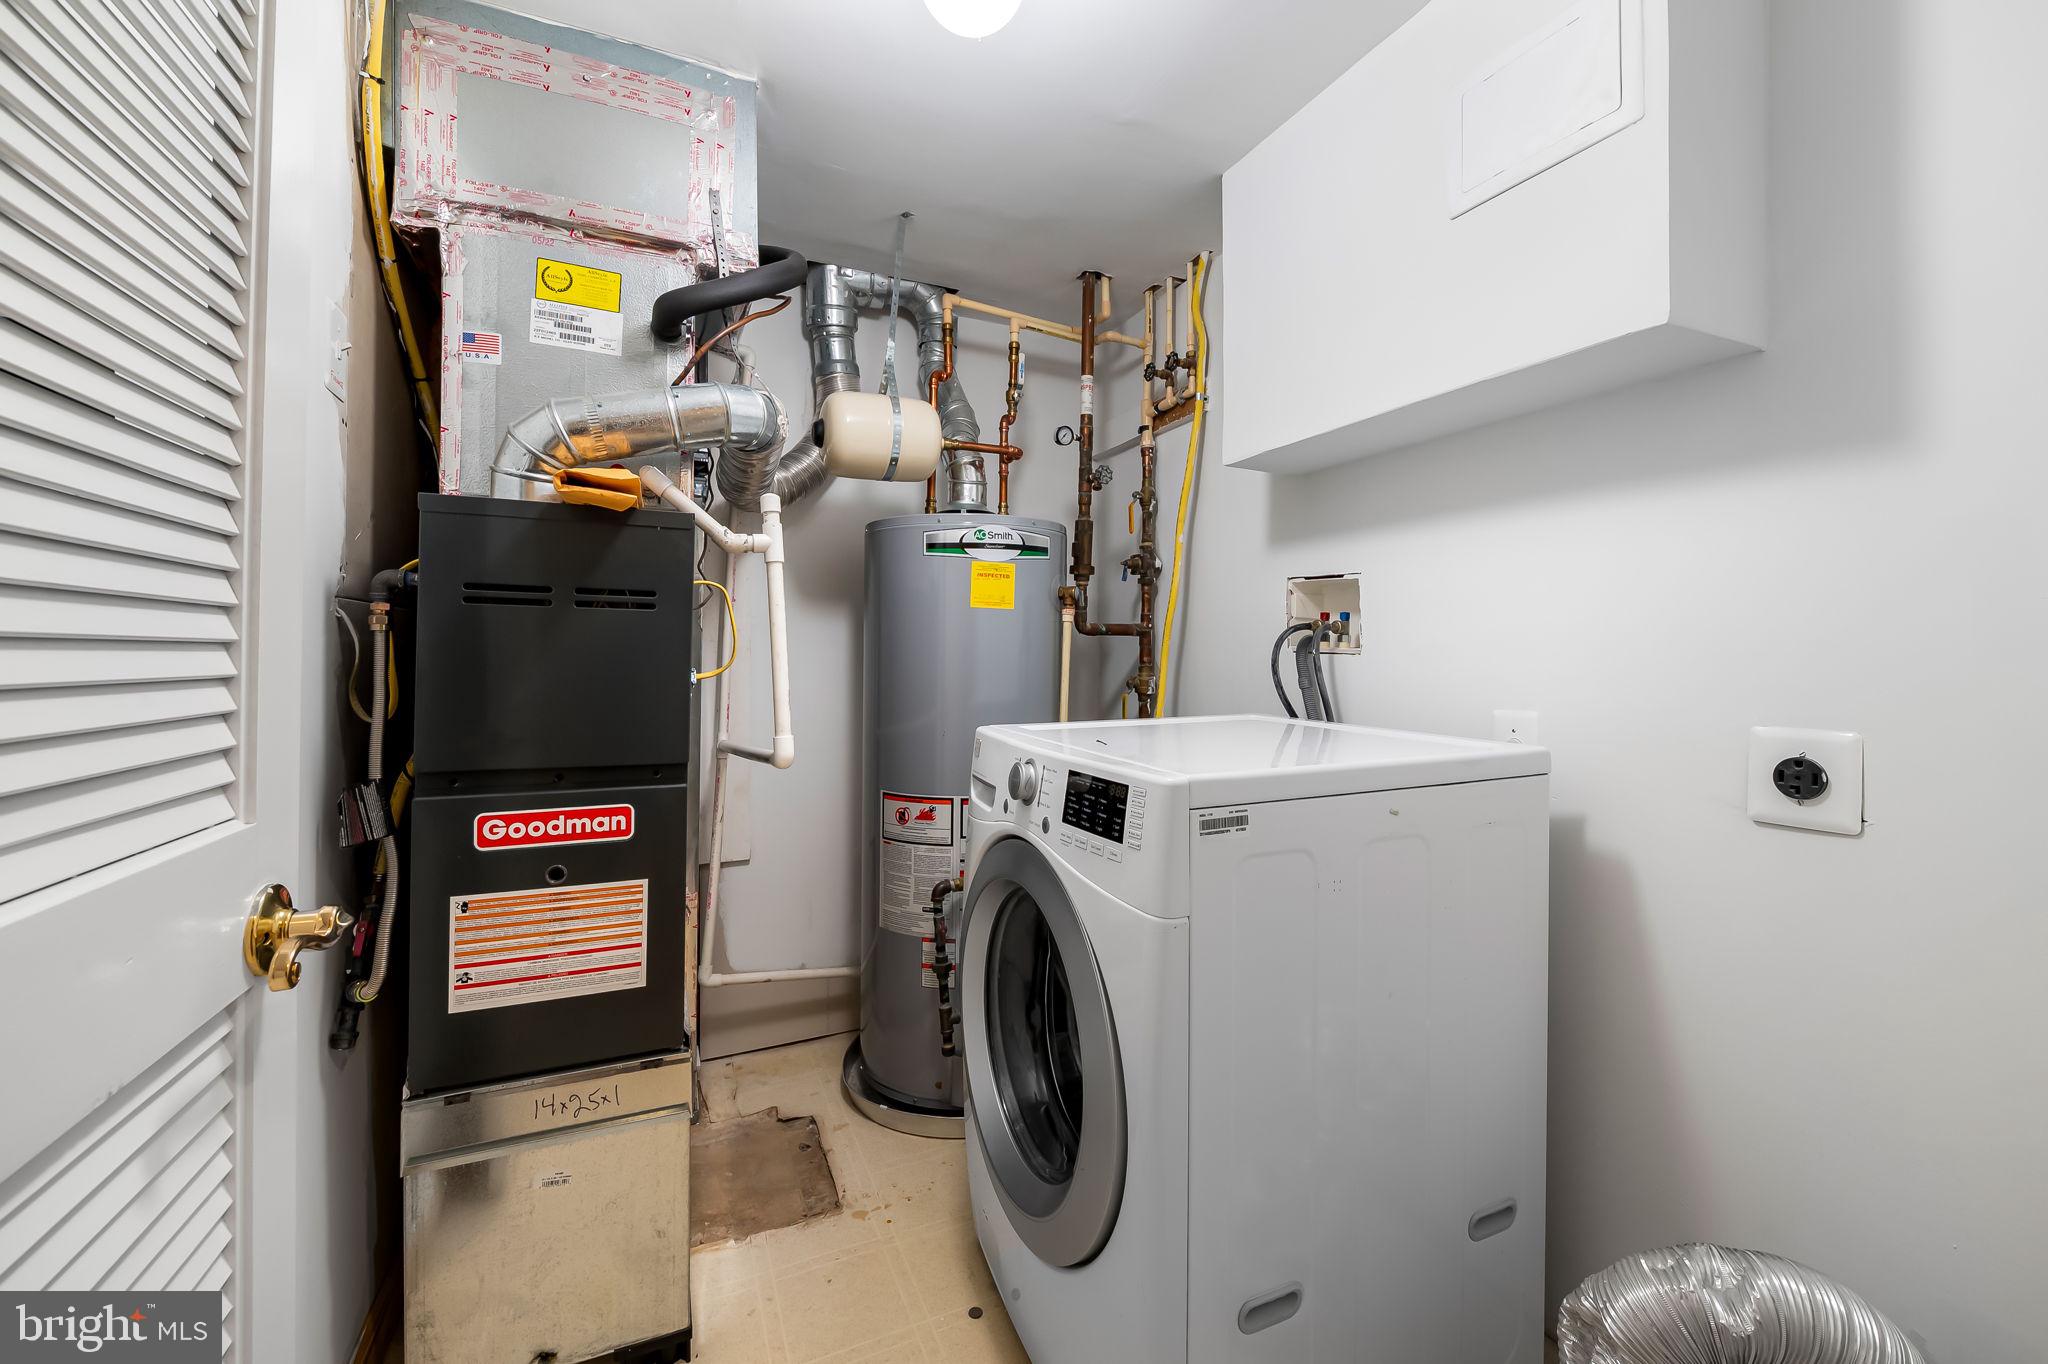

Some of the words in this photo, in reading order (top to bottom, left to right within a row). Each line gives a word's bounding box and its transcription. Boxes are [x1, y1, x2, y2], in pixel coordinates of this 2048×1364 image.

[987, 531, 1013, 540] Smith
[482, 813, 627, 840] Goodman
[534, 1084, 620, 1120] 14x25x1
